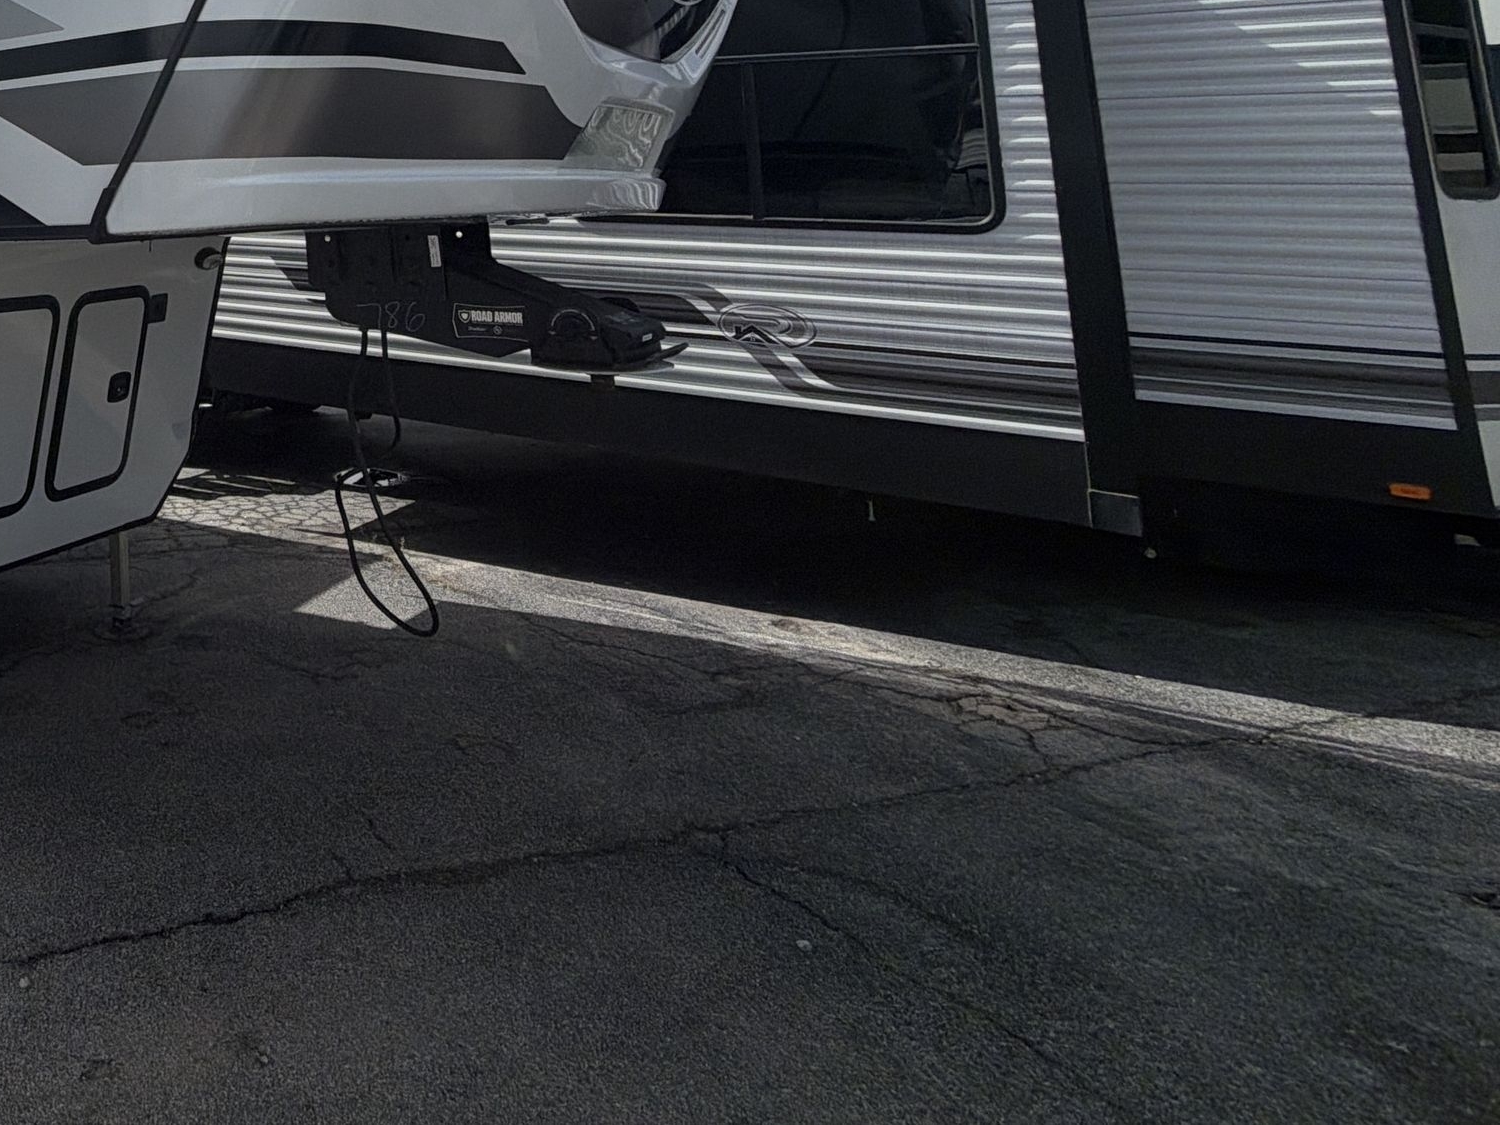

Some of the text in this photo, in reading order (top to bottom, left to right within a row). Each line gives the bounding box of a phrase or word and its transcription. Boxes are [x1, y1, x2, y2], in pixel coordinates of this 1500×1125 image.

[356, 301, 426, 332] 786
[471, 310, 523, 324] ROAD ARMOR
